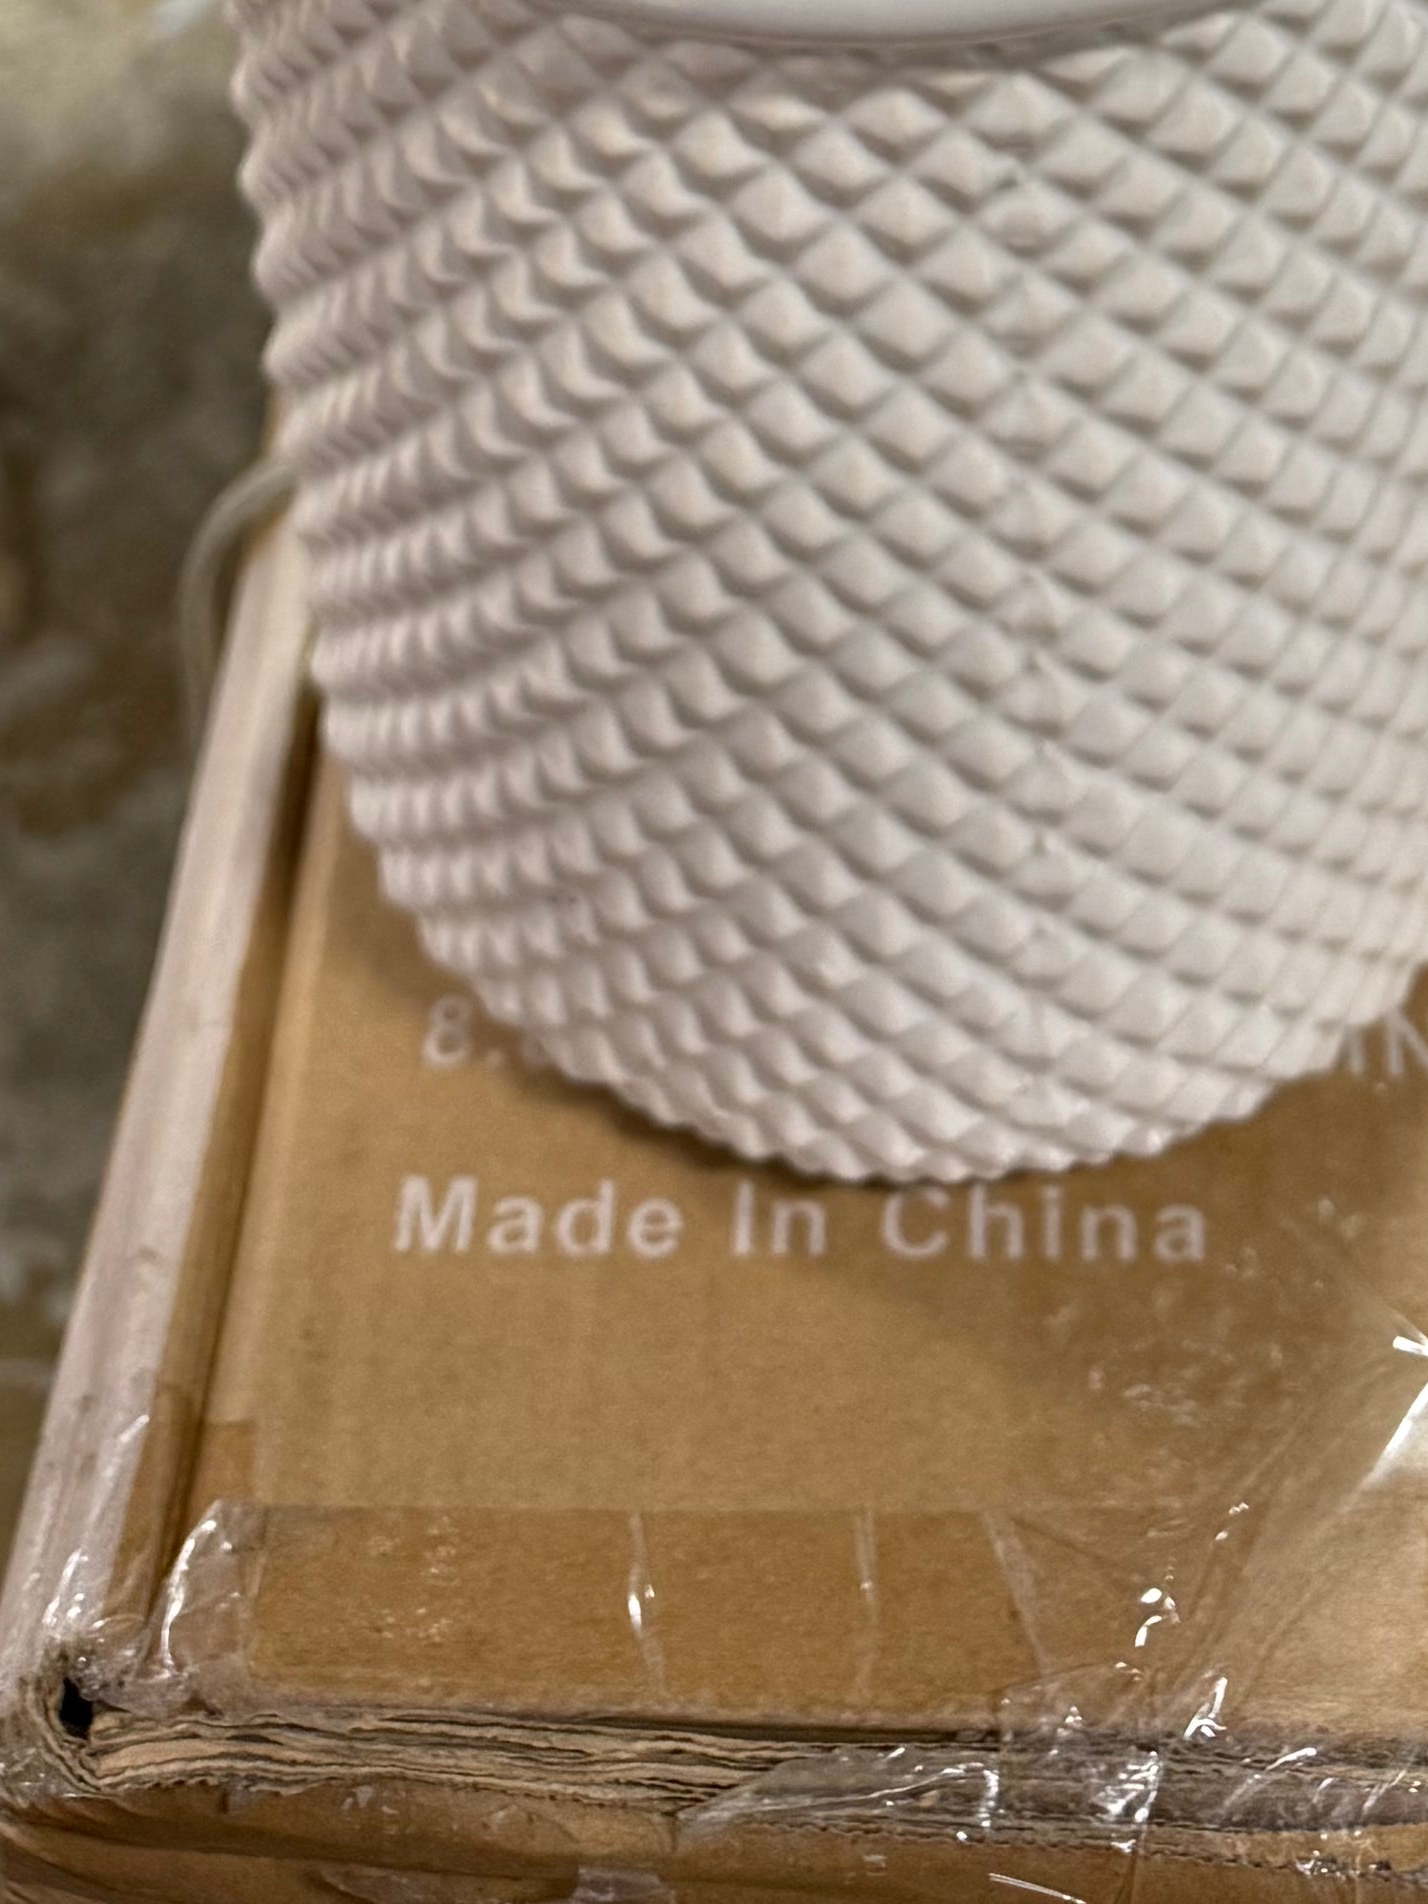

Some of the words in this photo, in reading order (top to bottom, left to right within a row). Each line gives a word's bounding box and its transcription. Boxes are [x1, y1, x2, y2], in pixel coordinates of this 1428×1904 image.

[393, 1174, 684, 1259] Made
[731, 1179, 829, 1259] In
[880, 1181, 1208, 1262] China
